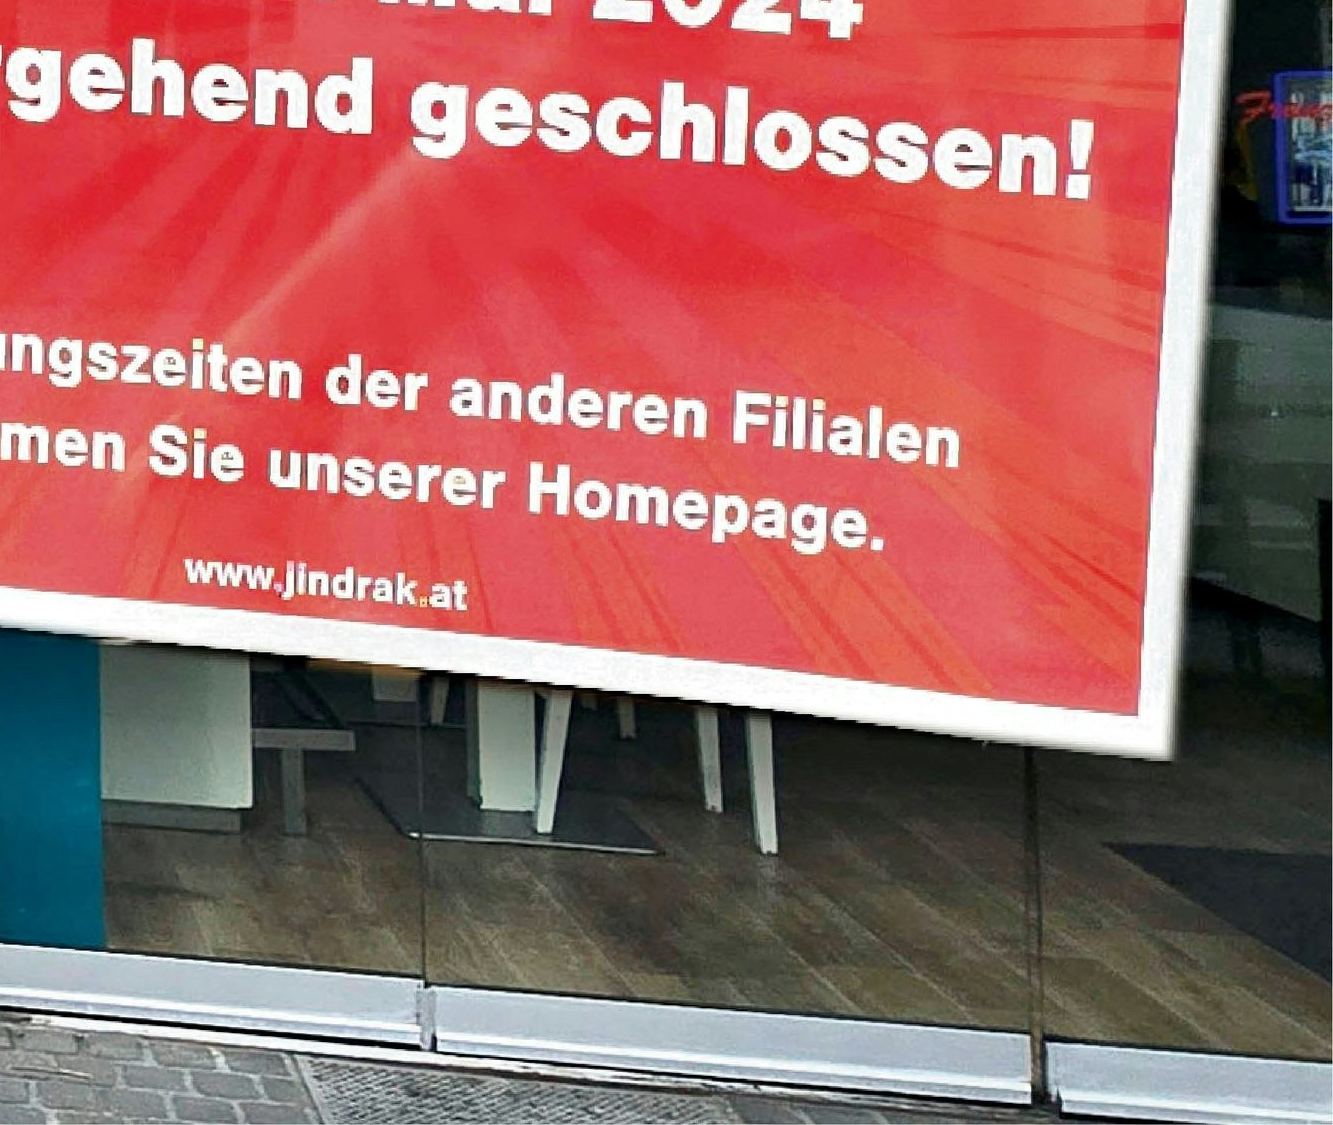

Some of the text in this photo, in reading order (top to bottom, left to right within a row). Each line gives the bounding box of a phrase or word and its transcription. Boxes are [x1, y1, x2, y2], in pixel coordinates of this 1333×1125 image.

[410, 80, 1095, 200] geschlossen!
[325, 354, 428, 411] der
[449, 372, 707, 439] anderen
[733, 389, 961, 468] Filialen
[148, 424, 245, 482] Sie
[269, 449, 506, 511] unserer
[529, 461, 884, 555] Homepage.
[184, 558, 468, 611] www.jindrak.at
